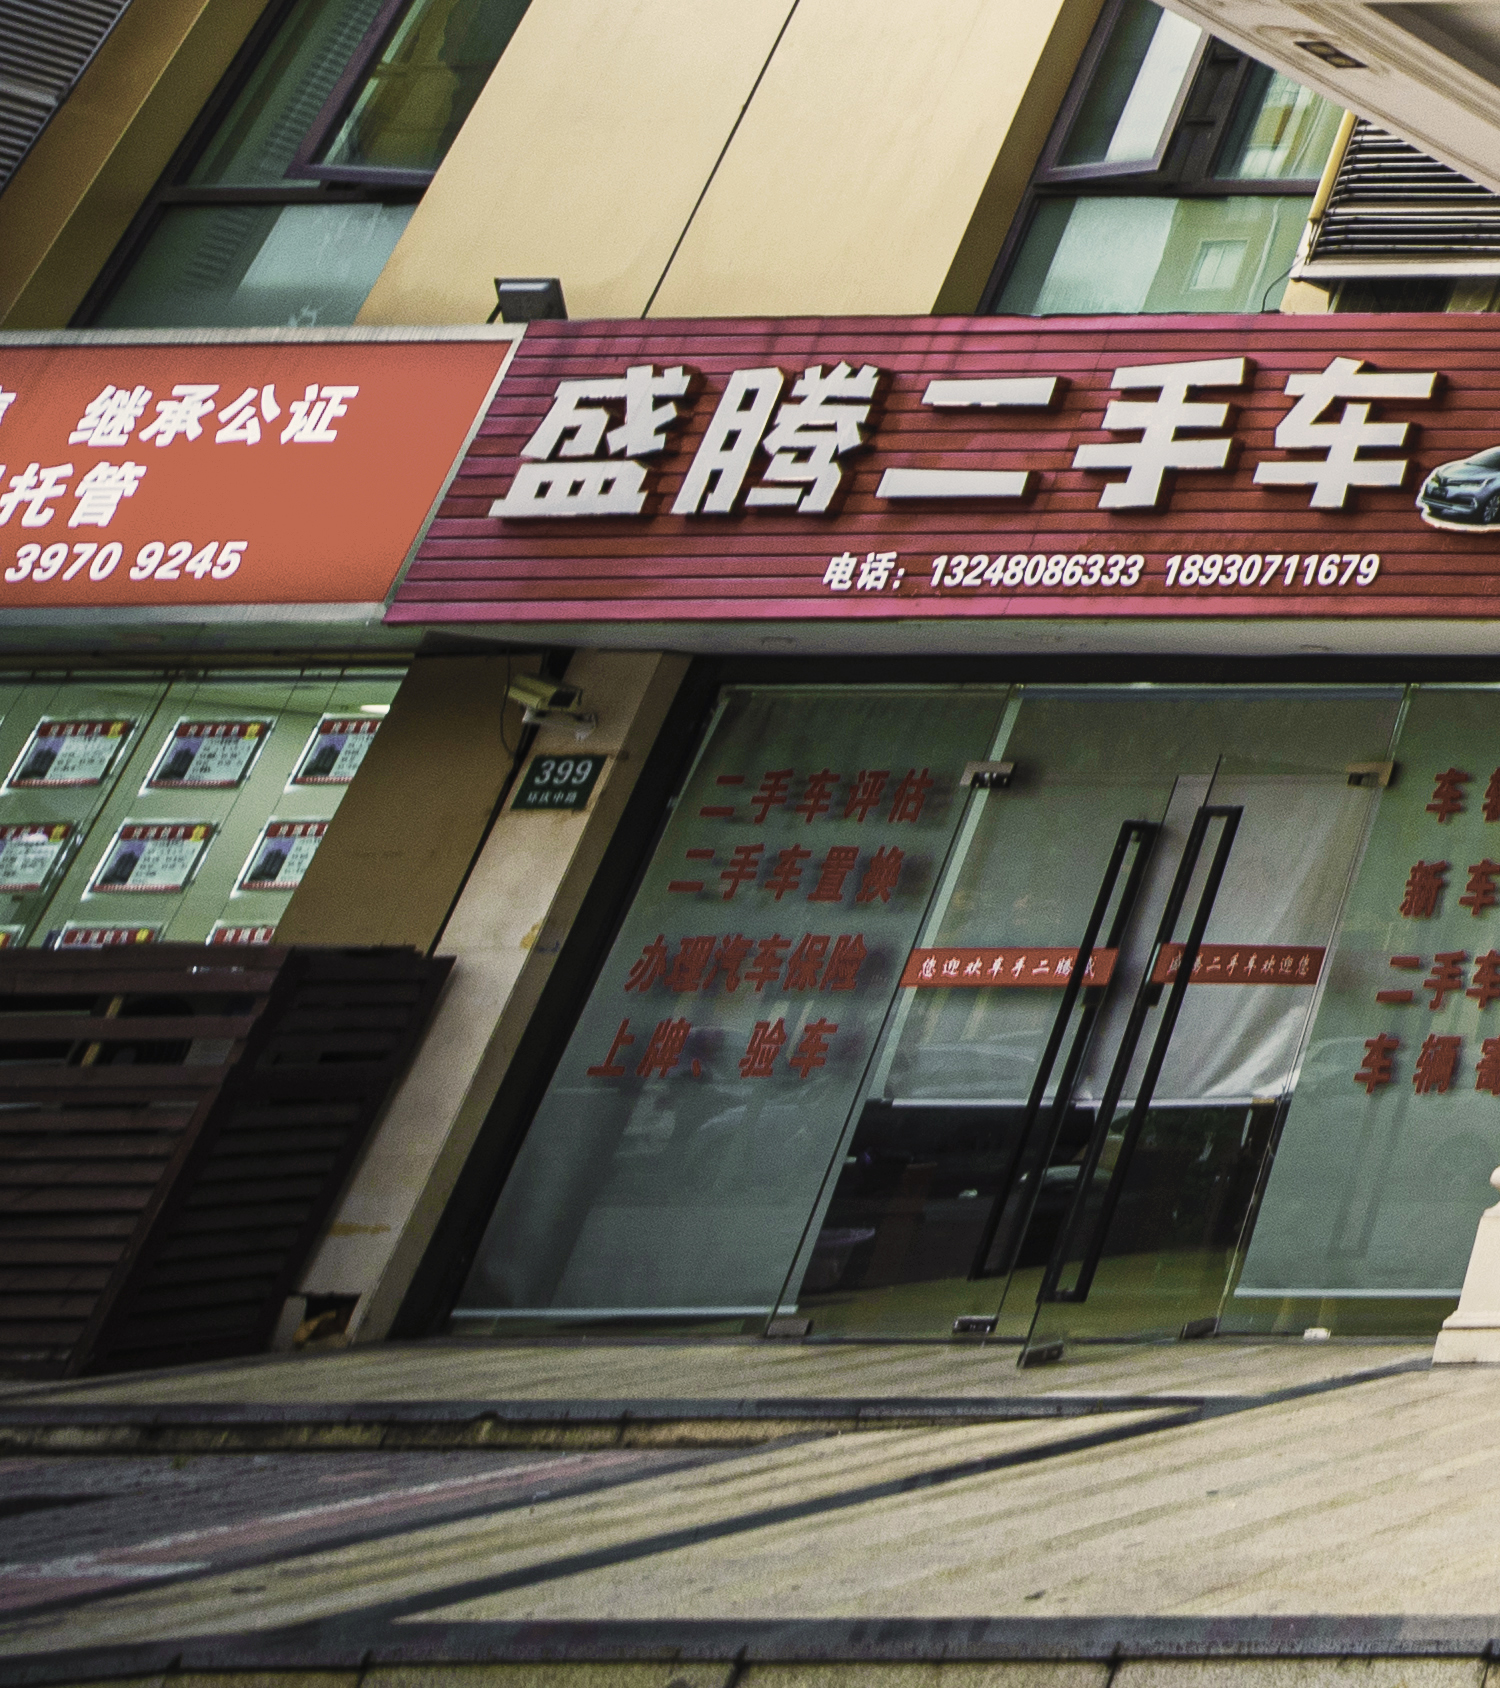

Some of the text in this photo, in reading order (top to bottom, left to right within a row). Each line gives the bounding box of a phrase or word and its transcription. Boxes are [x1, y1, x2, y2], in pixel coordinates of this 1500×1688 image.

[68, 383, 360, 447] 继承公证
[492, 356, 1438, 517] 盛腾二手车
[0, 460, 147, 528] 托管
[4, 540, 248, 583] 3970 9245
[929, 554, 1145, 588] 13248086333
[1164, 553, 1380, 588] 18930711679
[533, 759, 593, 785] 399
[699, 767, 935, 825] 二手车评估
[667, 843, 904, 903] 二手车置换
[624, 932, 868, 993] 办理汽车保险
